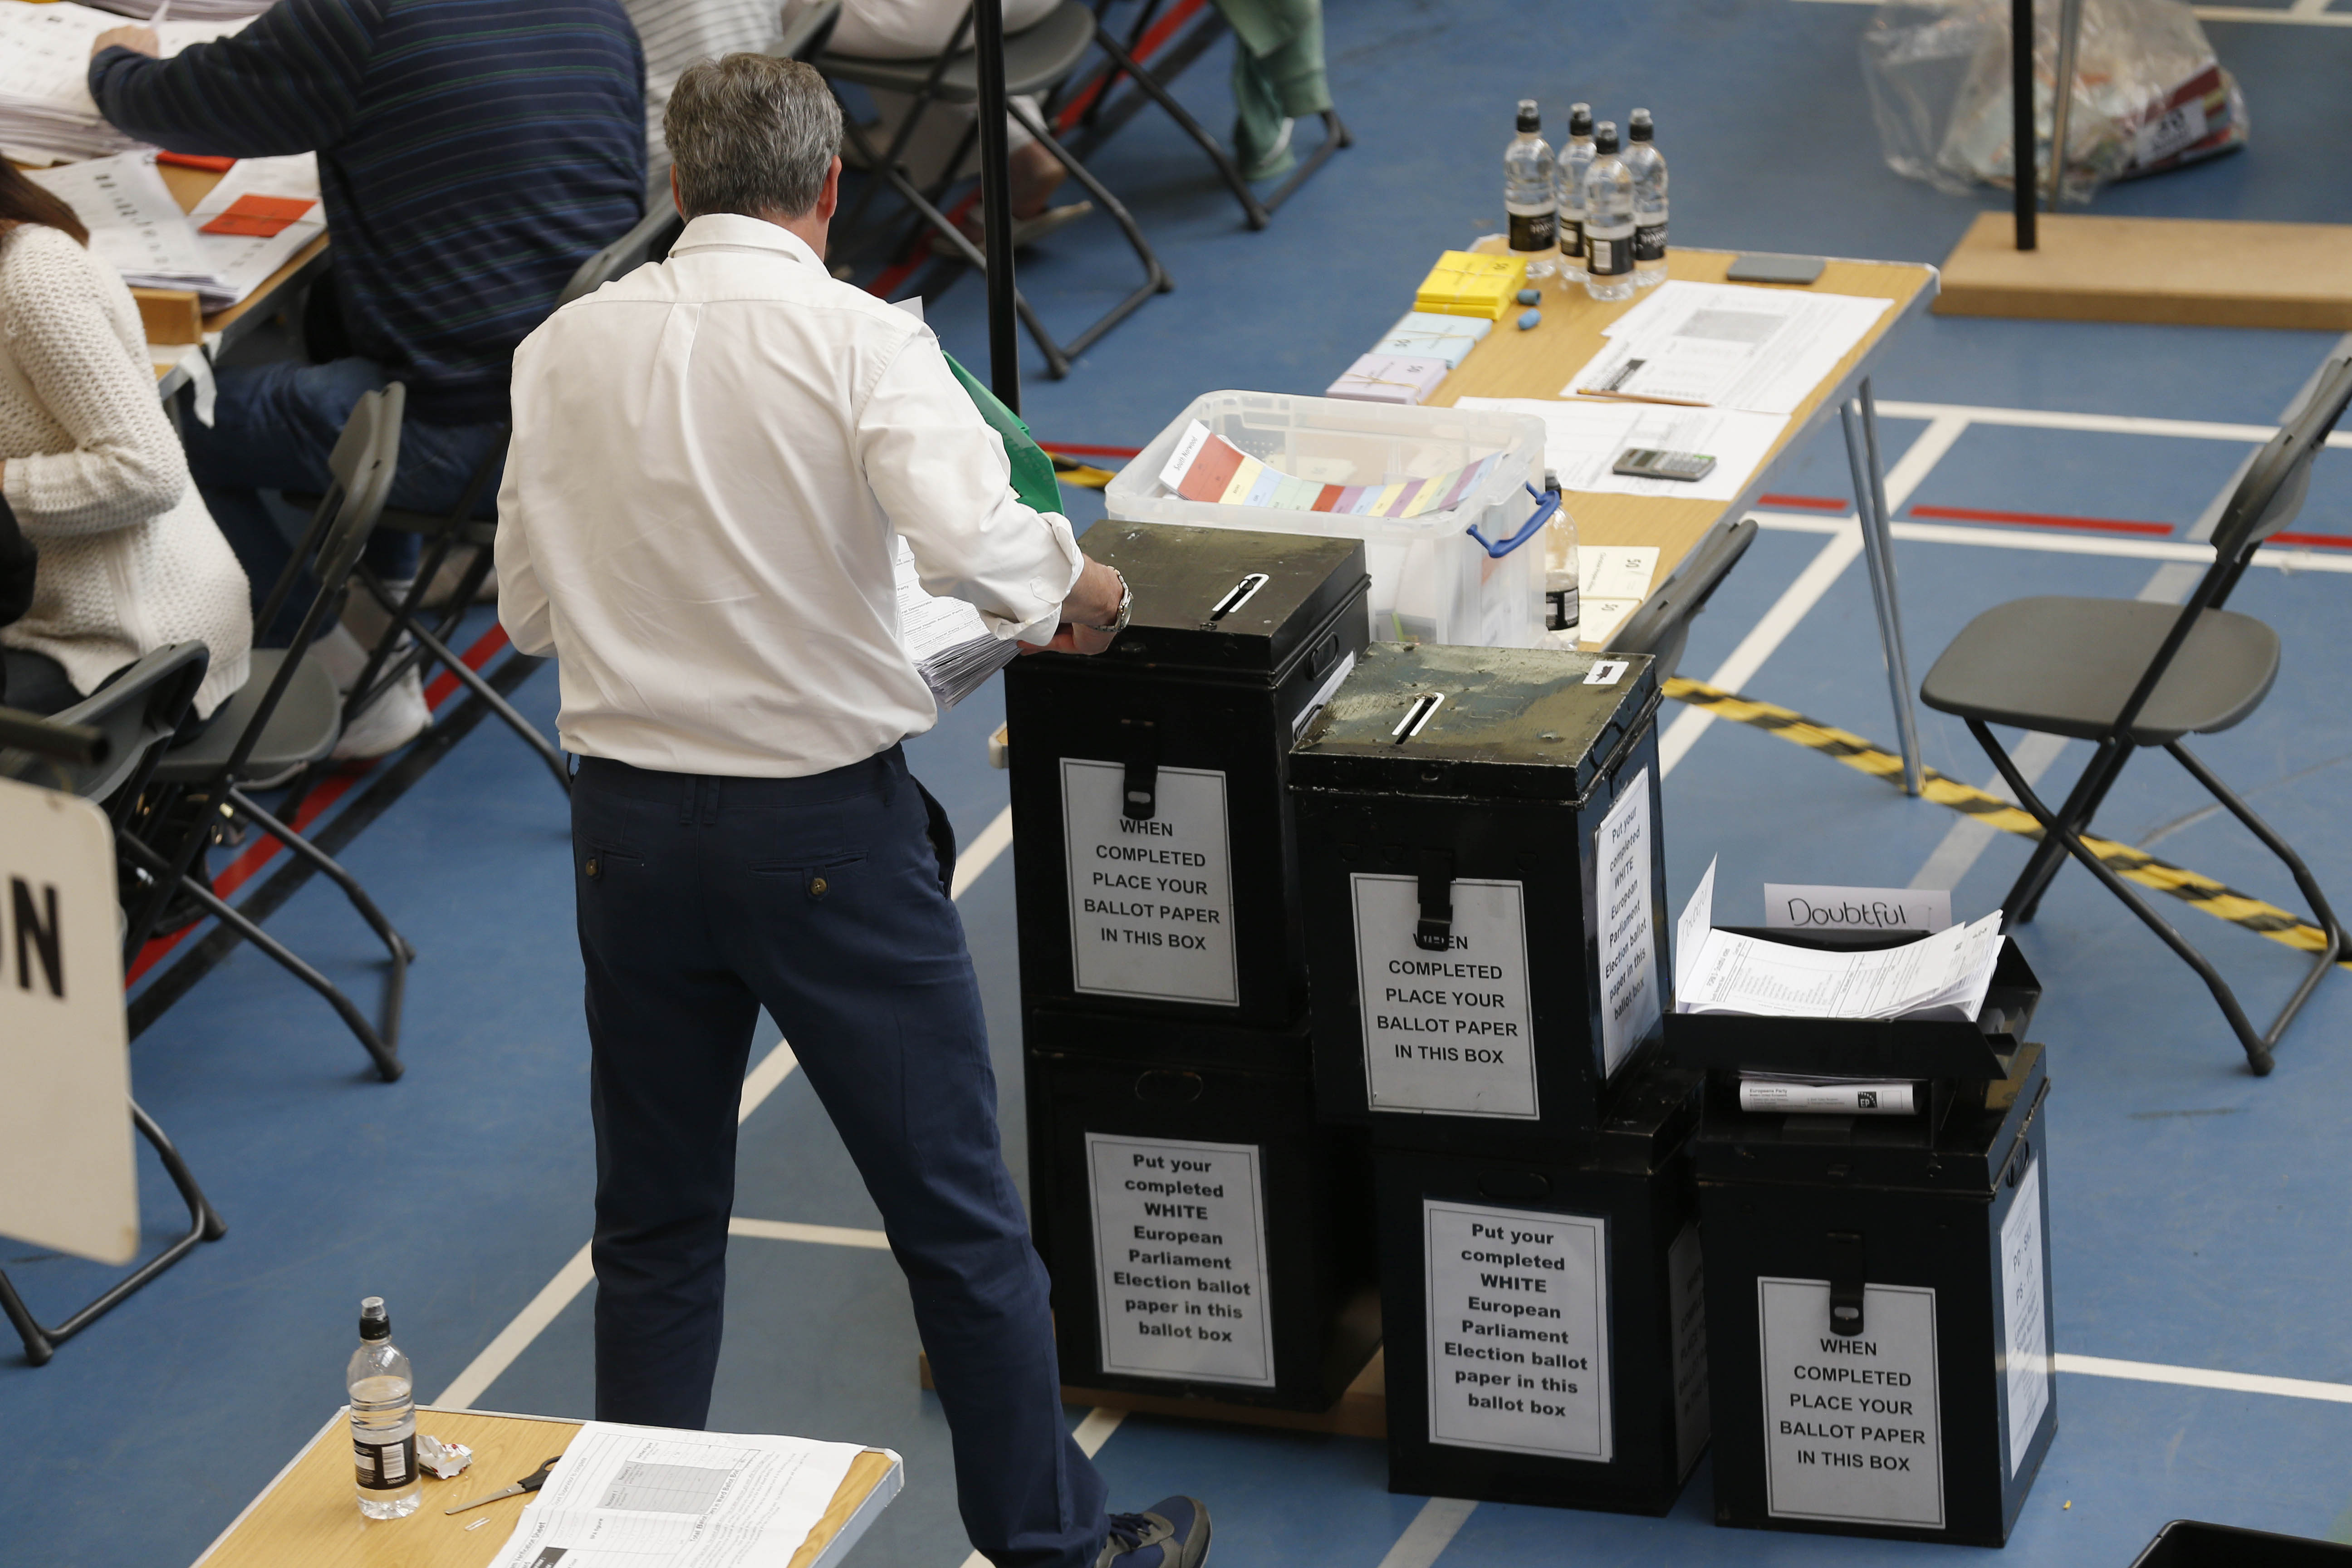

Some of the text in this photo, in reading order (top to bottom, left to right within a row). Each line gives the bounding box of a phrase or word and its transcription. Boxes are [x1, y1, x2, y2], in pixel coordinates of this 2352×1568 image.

[1174, 436, 1198, 470] South Norwood
[1120, 819, 1173, 836] WHEN
[1612, 806, 1637, 844] Put your
[1097, 845, 1205, 867] COMPLETED
[1610, 824, 1640, 872] completed
[1615, 855, 1633, 889] WHITE
[1093, 872, 1207, 895] PLACE YOUR
[1611, 879, 1638, 920] European
[1084, 899, 1220, 923] BALLOT PAPER
[1788, 898, 1906, 927] Doubtful
[1610, 899, 1640, 947] Parliament
[0, 876, 64, 999] N
[1102, 928, 1206, 950] IN THIS BOX
[1606, 917, 1646, 979] Election ballot
[1389, 960, 1502, 979] COMPLETED
[1610, 947, 1646, 1004] paper in this
[1387, 988, 1504, 1008] PLACE YOUR
[1614, 976, 1645, 1020] ballot box
[1377, 1016, 1517, 1036] BALLOT PAPER
[1396, 1044, 1504, 1063] IN THIS BOX
[1861, 1099, 1869, 1107] EP
[1133, 1154, 1211, 1173] Put your
[1125, 1180, 1223, 1197] completed
[1145, 1202, 1207, 1220] WHITE
[1134, 1225, 1222, 1245] European
[1472, 1223, 1553, 1245] Put your
[1129, 1249, 1231, 1269] Parliament
[1461, 1250, 1564, 1270] completed
[2013, 1248, 2021, 1273] PD
[1114, 1271, 1250, 1295] Election ballot
[1481, 1273, 1546, 1293] WHITE
[1126, 1300, 1242, 1318] paper in this
[1469, 1296, 1560, 1318] European
[1139, 1321, 1232, 1342] ballot box
[1462, 1320, 1568, 1344] Parliament
[1445, 1342, 1587, 1370] Election ballot
[1820, 1338, 1876, 1356] WHEN
[1455, 1371, 1578, 1393] paper in this
[1794, 1366, 1911, 1386] COMPLETED
[1469, 1393, 1565, 1416] ballot box
[1790, 1394, 1912, 1415] PLACE YOUR
[1781, 1421, 1925, 1444] BALLOT PAPER
[1798, 1450, 1910, 1471] IN THIS BOX
[690, 1530, 701, 1542] Total
[722, 1480, 734, 1491] Ballot
[531, 1522, 546, 1538] Sheet
